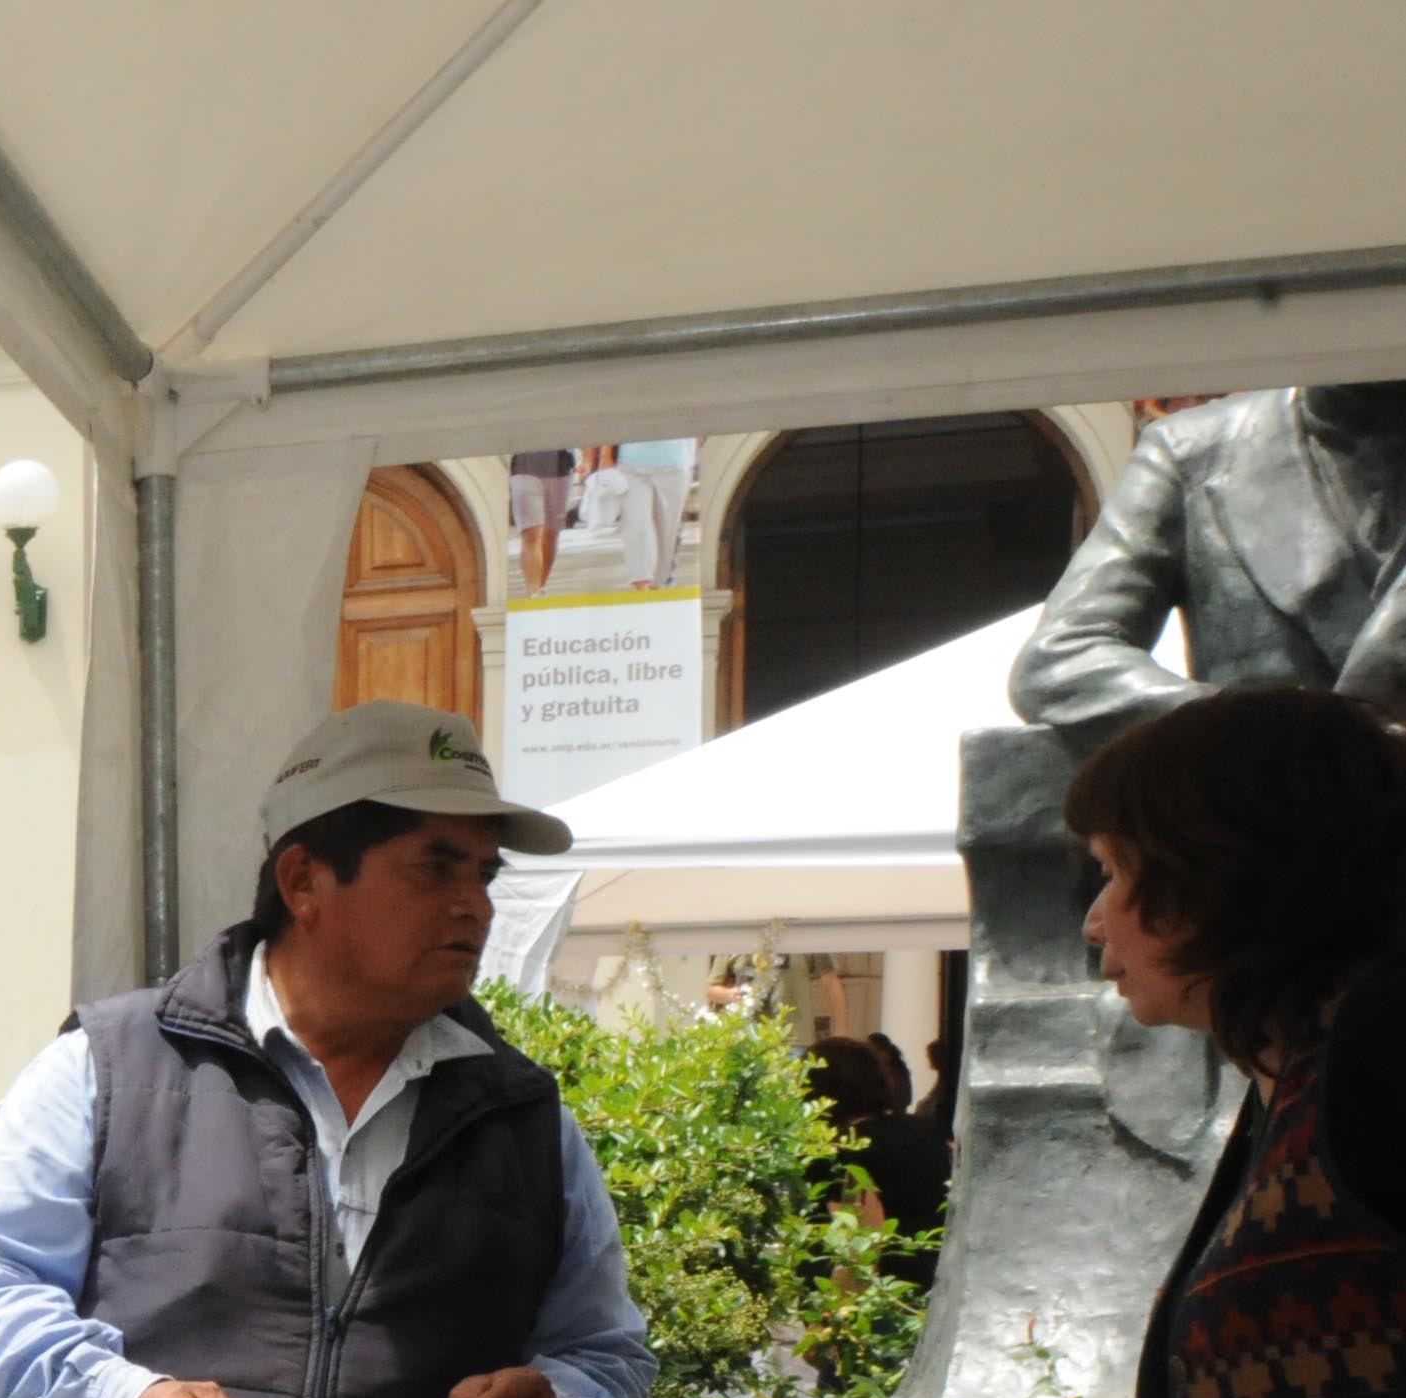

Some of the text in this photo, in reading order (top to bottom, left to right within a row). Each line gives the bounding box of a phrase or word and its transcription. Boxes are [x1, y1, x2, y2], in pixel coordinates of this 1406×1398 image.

[522, 630, 651, 657] Educación
[522, 661, 684, 692] pública, libre
[521, 695, 640, 723] y gratuita
